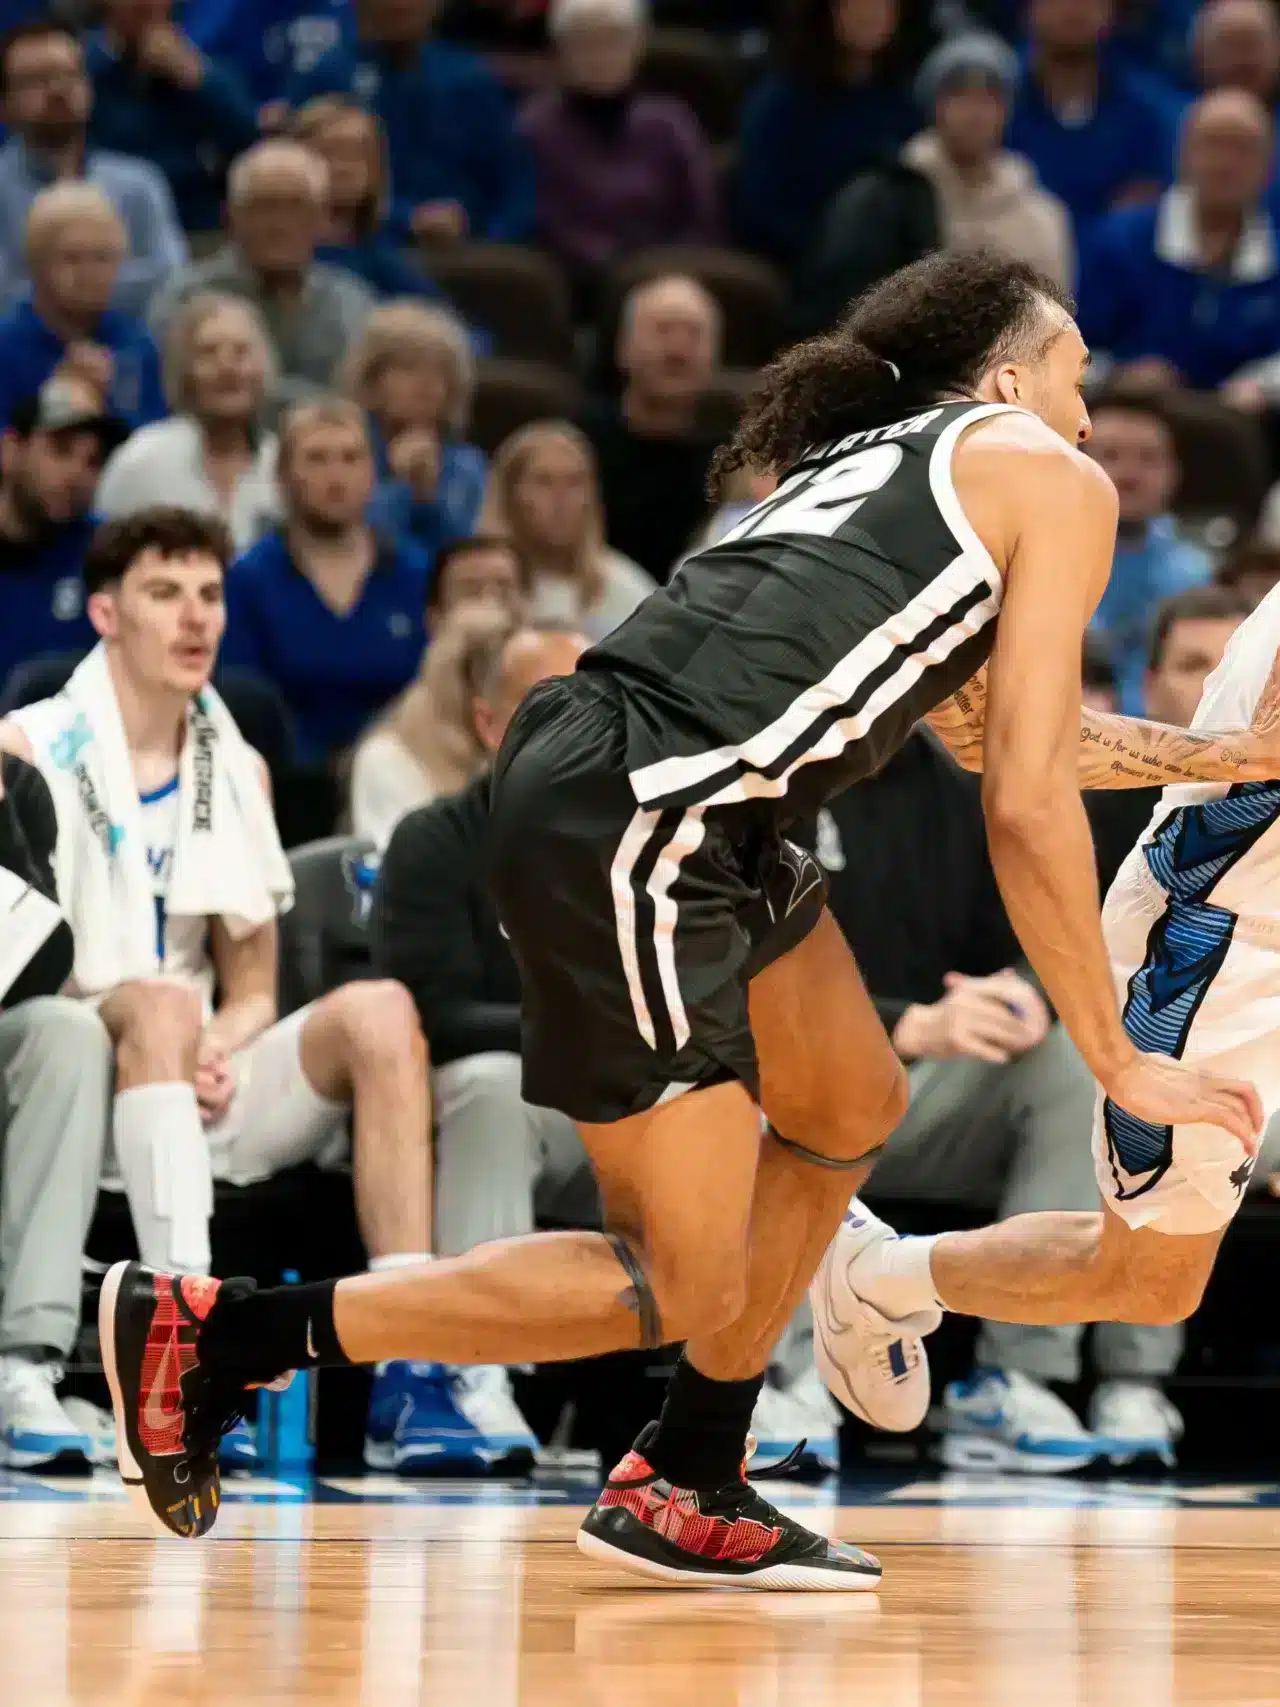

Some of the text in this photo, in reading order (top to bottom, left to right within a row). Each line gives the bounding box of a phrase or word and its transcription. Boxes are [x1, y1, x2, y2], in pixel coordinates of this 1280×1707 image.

[1080, 726, 1103, 743] God
[1103, 736, 1112, 747] is
[1110, 738, 1128, 753] for
[1128, 749, 1140, 760] us
[1141, 753, 1163, 768] who
